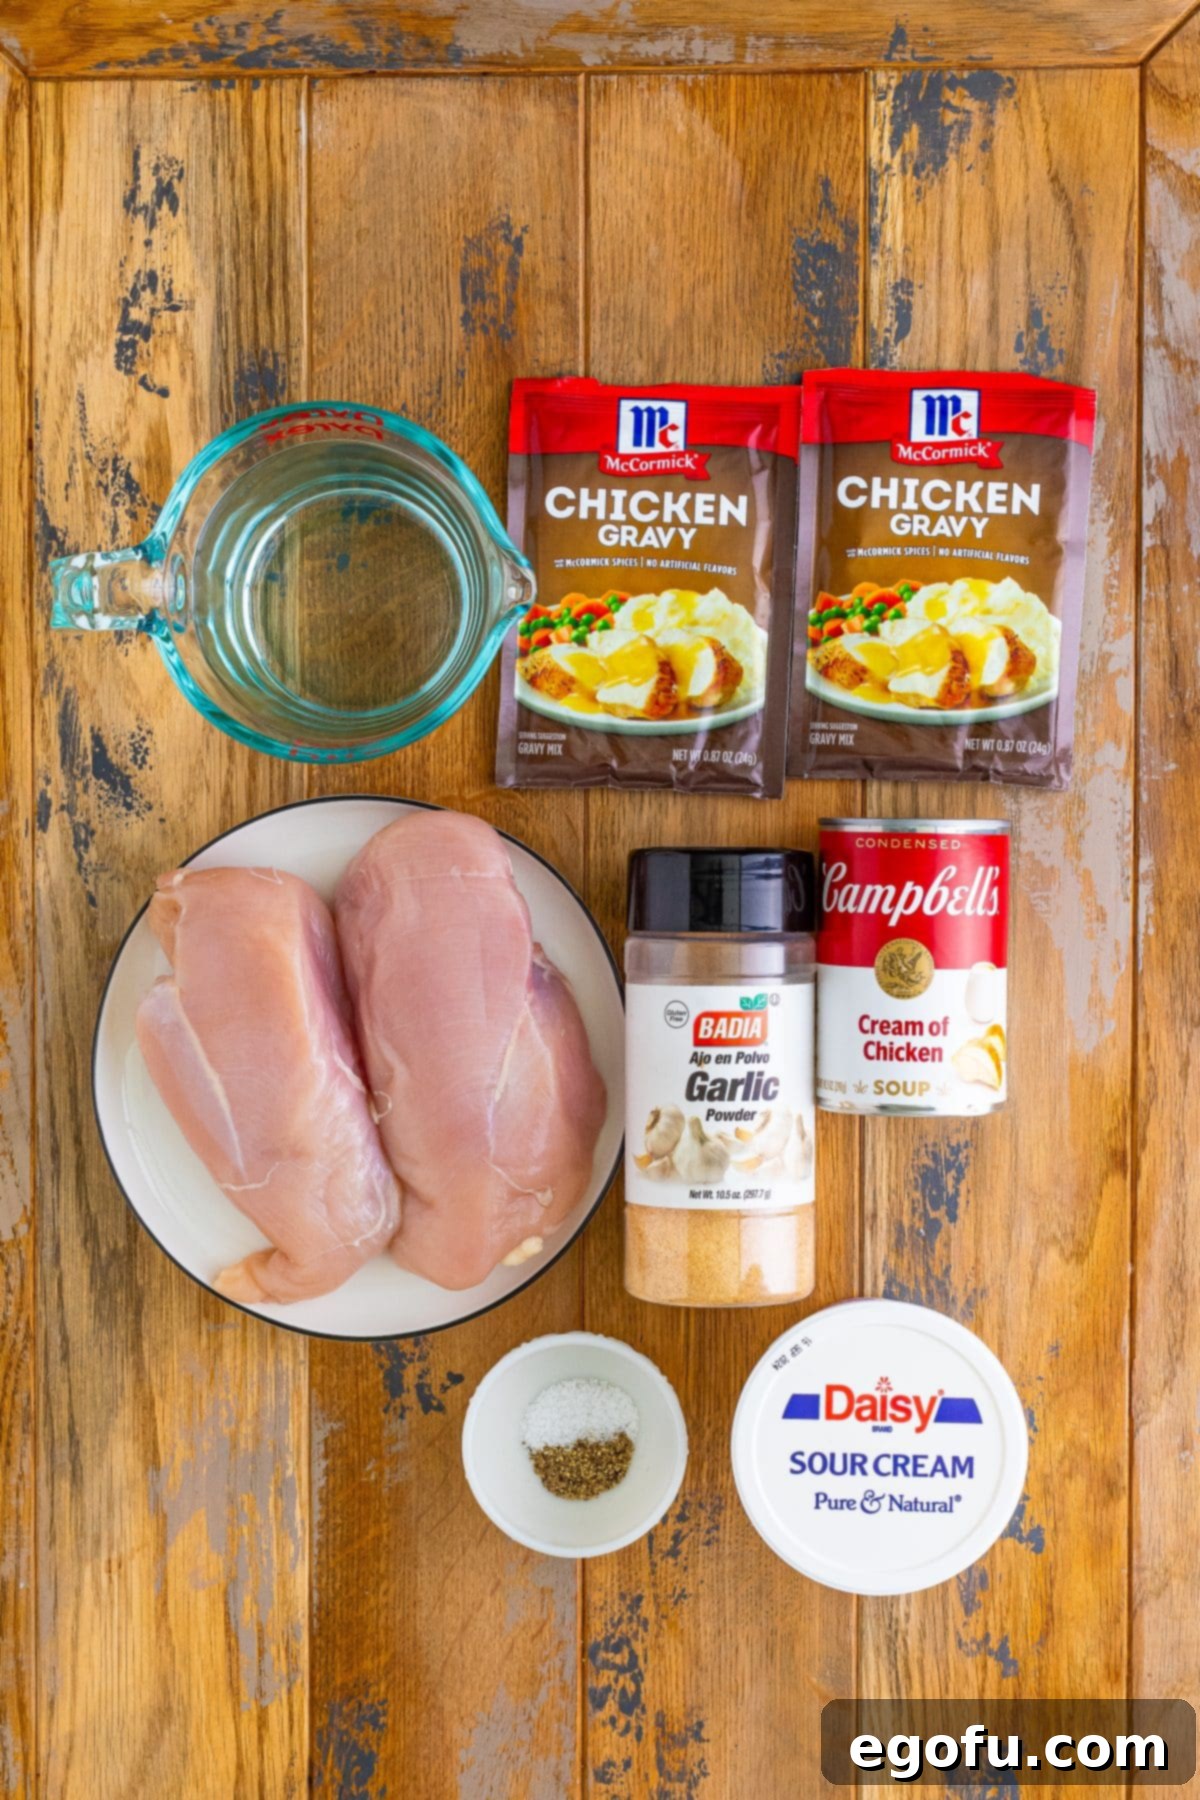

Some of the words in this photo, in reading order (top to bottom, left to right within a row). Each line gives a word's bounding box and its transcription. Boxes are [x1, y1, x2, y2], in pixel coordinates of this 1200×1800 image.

[897, 443, 989, 461] McCormick
[604, 454, 696, 472] McCormick
[837, 476, 1041, 516] CHICKEN
[544, 486, 748, 527] CHICKEN
[889, 513, 990, 538] GRAVY
[597, 524, 698, 549] GRAVY
[857, 547, 901, 557] McCORMICK
[904, 547, 930, 557] SPICES
[938, 548, 950, 557] NO
[953, 549, 994, 561] ARTIFICIAL
[996, 553, 1030, 565] FLAVORS
[565, 558, 610, 567] McCORMICK
[612, 558, 638, 567] SPICES
[646, 559, 657, 568] NO
[660, 560, 701, 572] ARTIFICIAL
[703, 563, 737, 576] FLAVORS
[809, 733, 836, 745] GRAVY
[838, 734, 855, 746] MIX
[964, 739, 980, 750] NET
[981, 739, 995, 751] WT
[996, 740, 1015, 752] 0.87
[518, 743, 545, 755] GRAVY
[547, 744, 563, 756] MIX
[672, 749, 689, 761] NET
[703, 750, 720, 762] 0.87
[855, 837, 961, 850] CONDENSED
[822, 861, 1000, 927] Campbell's
[698, 1017, 762, 1039] BADIA
[858, 1014, 924, 1036] Cream
[928, 1016, 950, 1037] of
[689, 1051, 711, 1067] Ajo
[715, 1055, 732, 1064] en
[735, 1051, 770, 1064] Polvo
[863, 1041, 943, 1062] Chicken
[685, 1071, 780, 1102] Garlic
[873, 1080, 931, 1097] SOUP
[706, 1109, 757, 1122] Powder
[689, 1190, 701, 1199] Net
[716, 1190, 730, 1199] 10.5
[825, 1384, 938, 1434] Daisy
[789, 1451, 868, 1477] SOUR
[873, 1453, 975, 1479] CREAM
[814, 1492, 857, 1511] Pure
[860, 1489, 886, 1515] &
